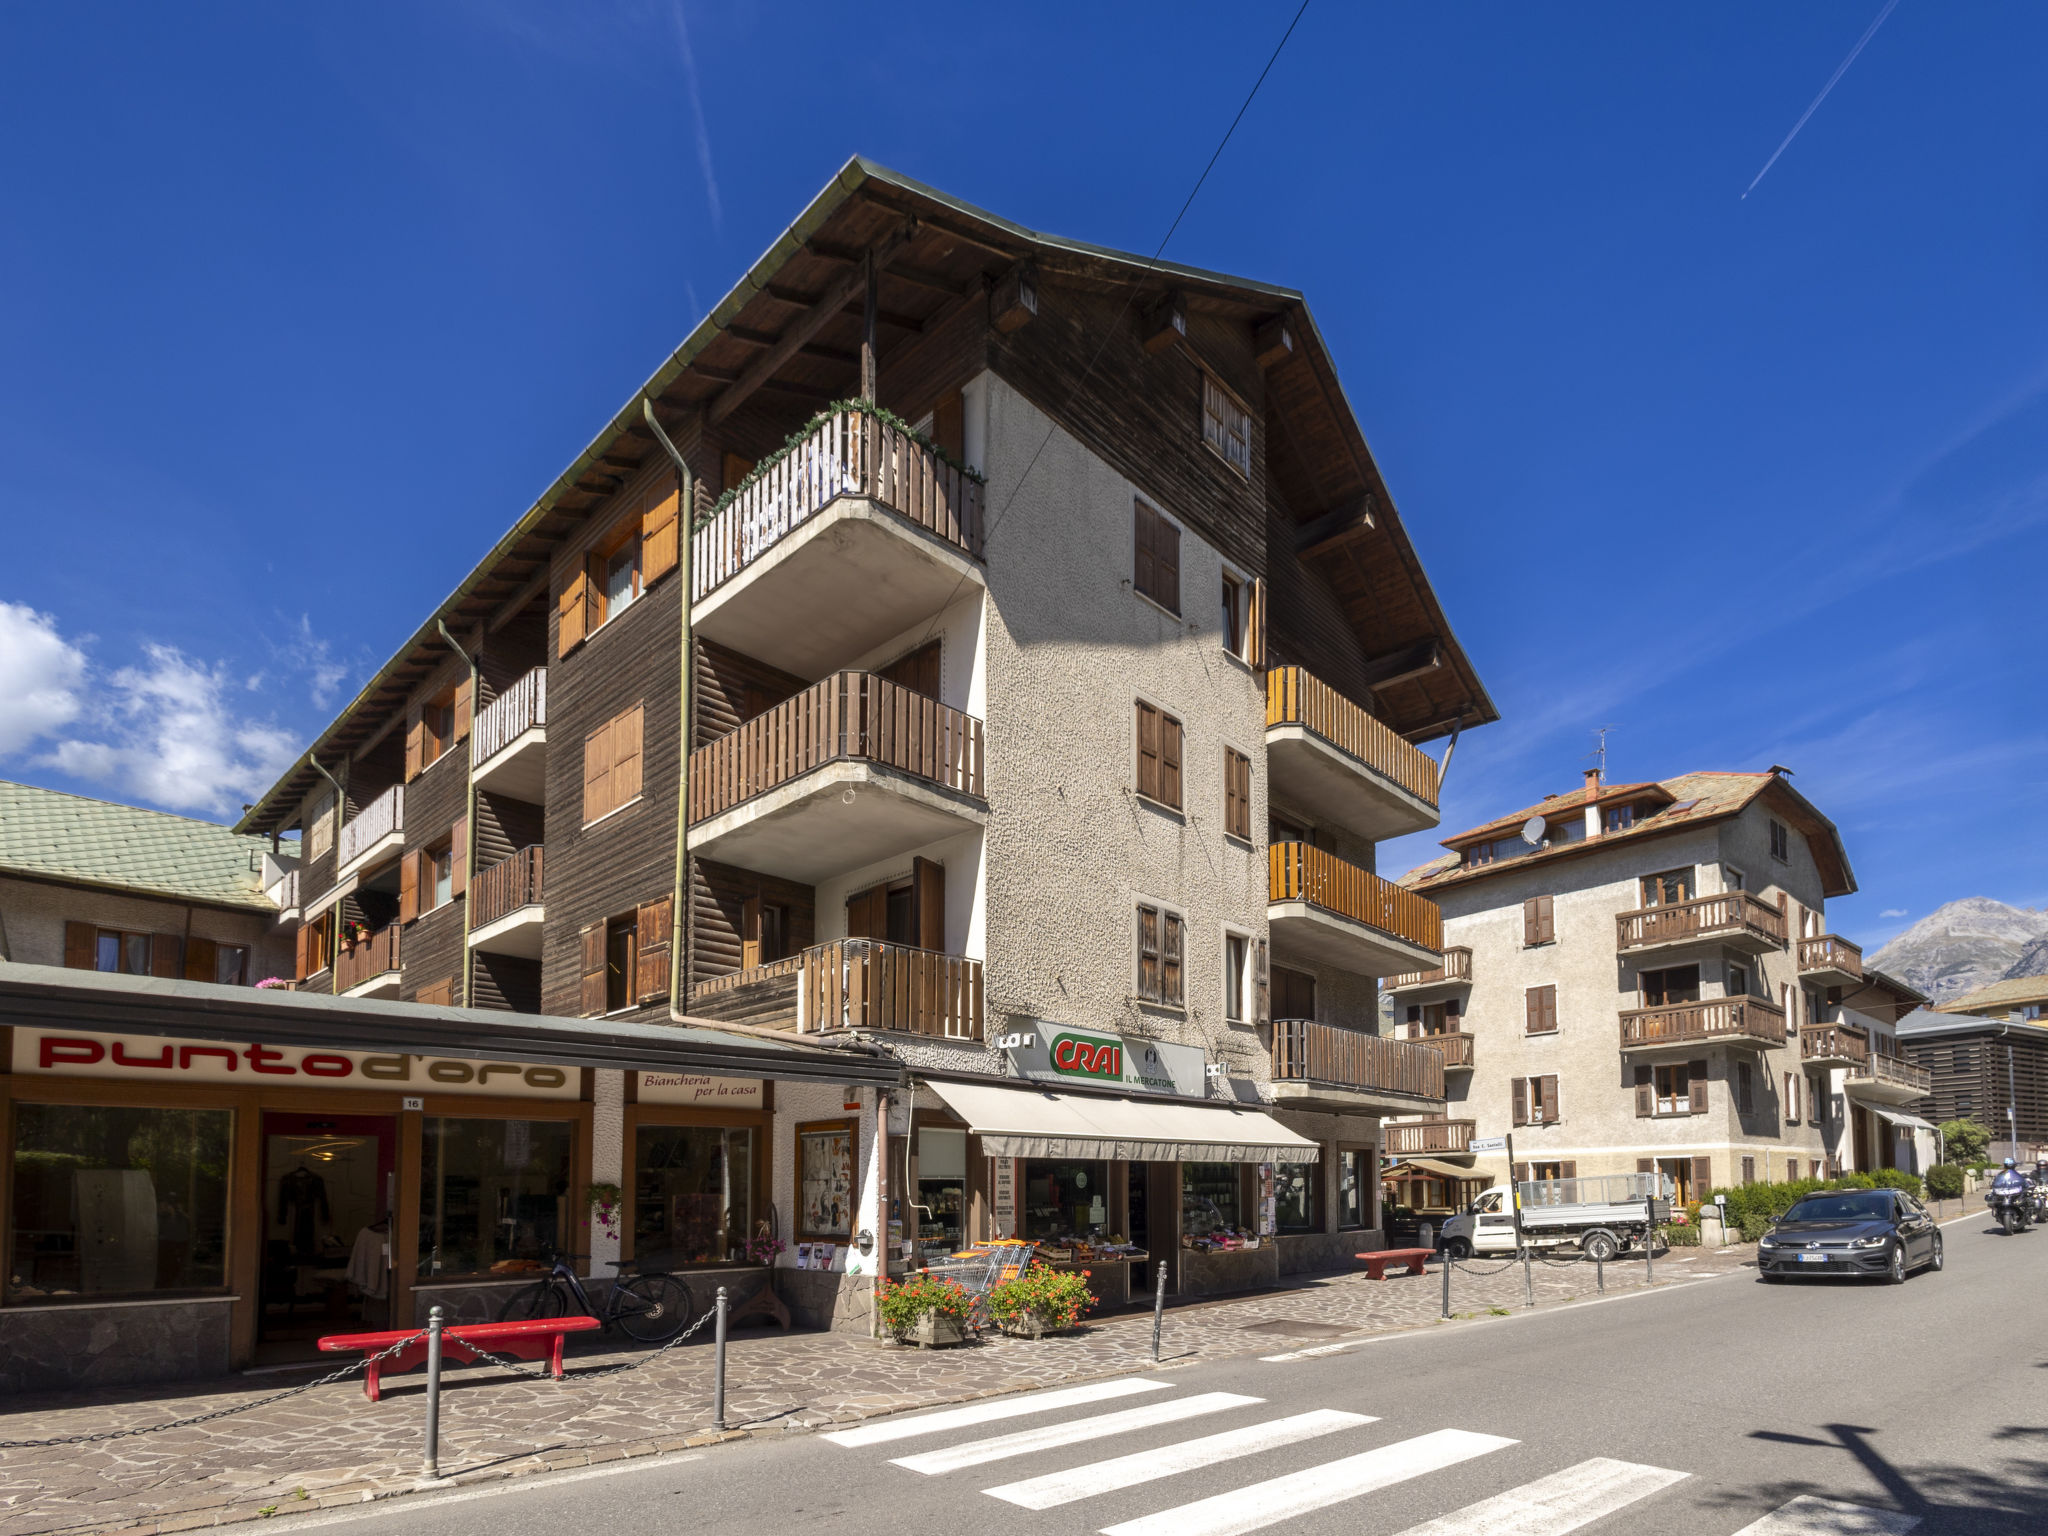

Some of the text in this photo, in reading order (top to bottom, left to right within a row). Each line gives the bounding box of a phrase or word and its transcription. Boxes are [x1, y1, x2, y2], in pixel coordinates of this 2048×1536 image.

[1054, 1038, 1120, 1076] CRAI
[644, 1073, 711, 1087] Biancheria
[1125, 1074, 1176, 1089] IL MERCATONE
[693, 1083, 757, 1101] per la casa
[407, 1100, 419, 1109] 16
